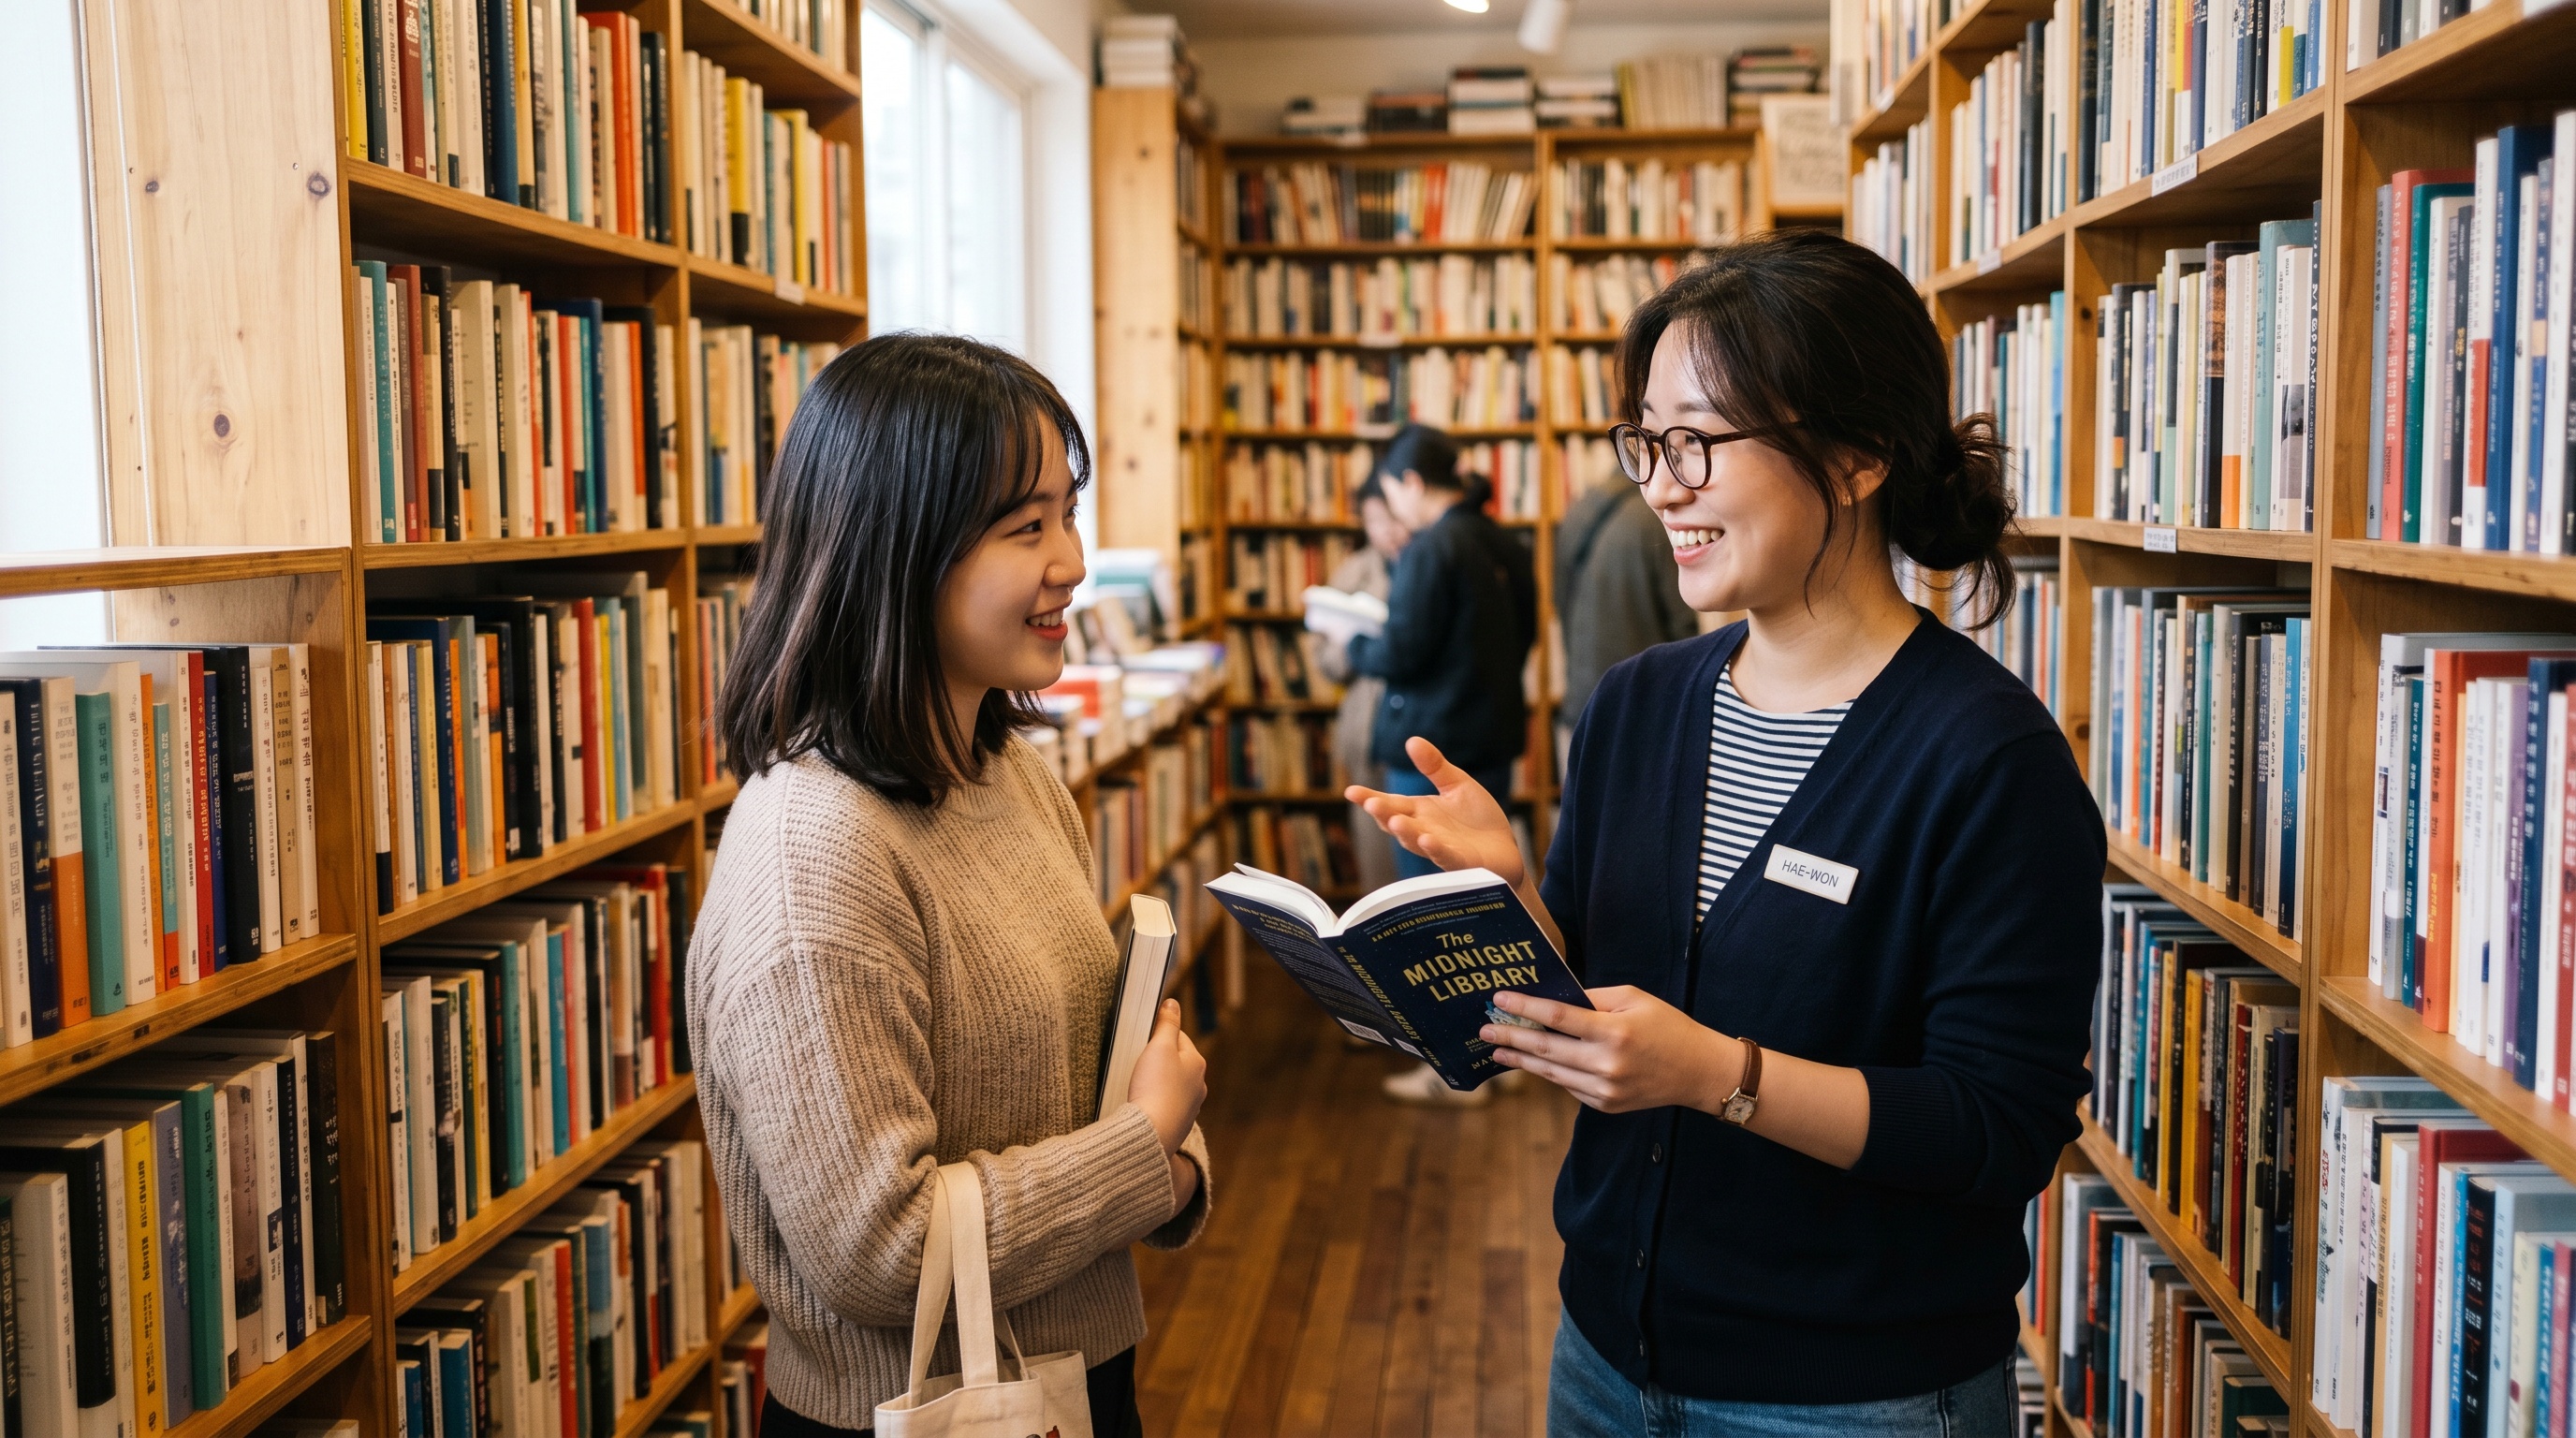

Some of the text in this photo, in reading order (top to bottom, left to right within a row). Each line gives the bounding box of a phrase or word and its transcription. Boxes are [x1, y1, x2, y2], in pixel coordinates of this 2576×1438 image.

[1782, 859, 1838, 887] HAE-WON
[1436, 932, 1474, 948] The
[1403, 941, 1536, 986] MIDNIGHT
